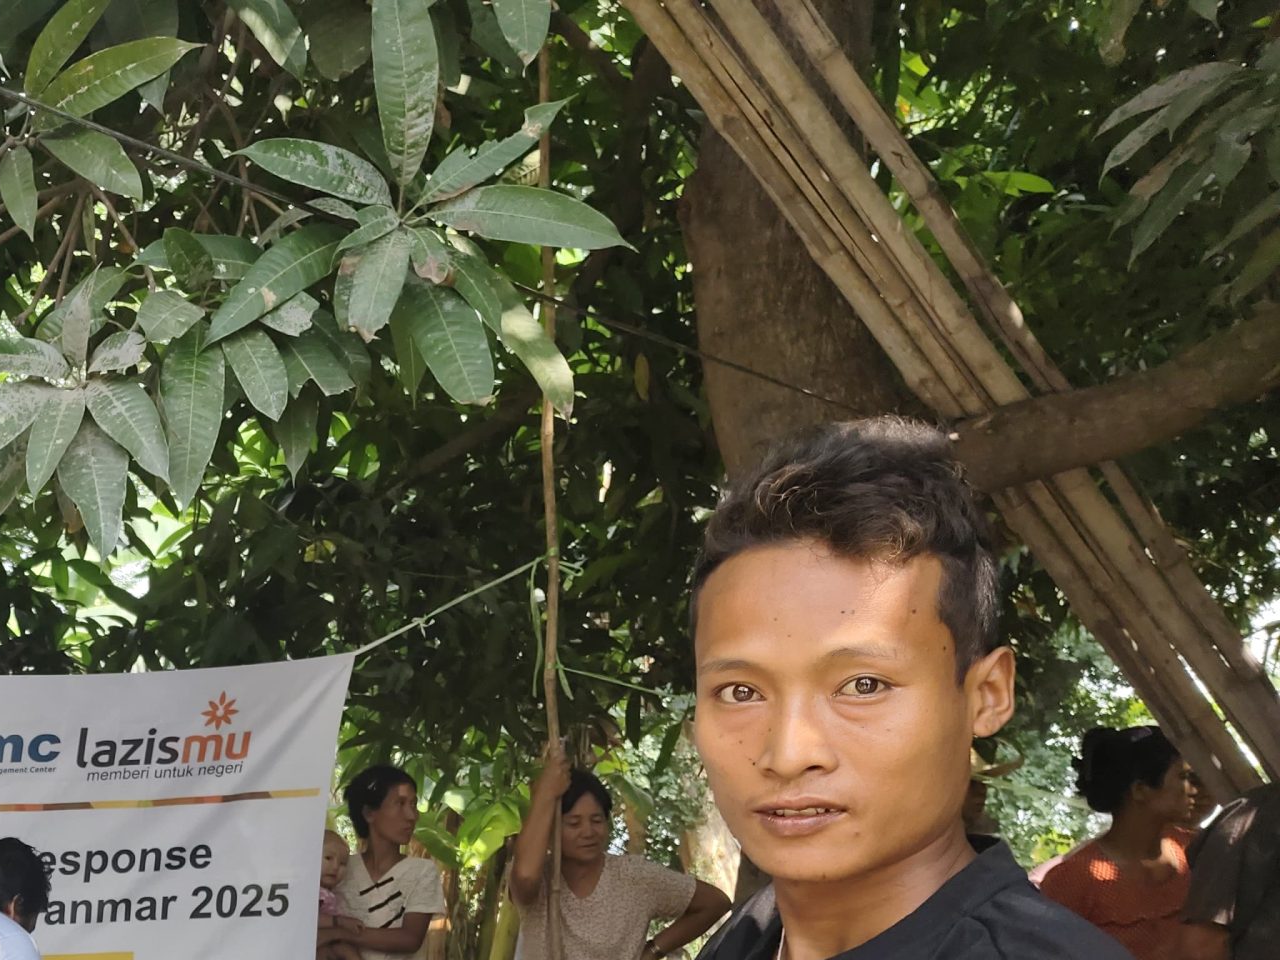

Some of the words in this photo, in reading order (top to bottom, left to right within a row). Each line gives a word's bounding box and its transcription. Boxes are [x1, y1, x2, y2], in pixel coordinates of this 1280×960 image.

[76, 727, 252, 768] lazismu
[29, 766, 57, 774] Center
[86, 766, 150, 782] memberi
[154, 765, 194, 780] untuk
[197, 760, 244, 778] negeri
[37, 842, 213, 883] esponse
[44, 893, 178, 925] anmar
[188, 882, 290, 920] 2025
